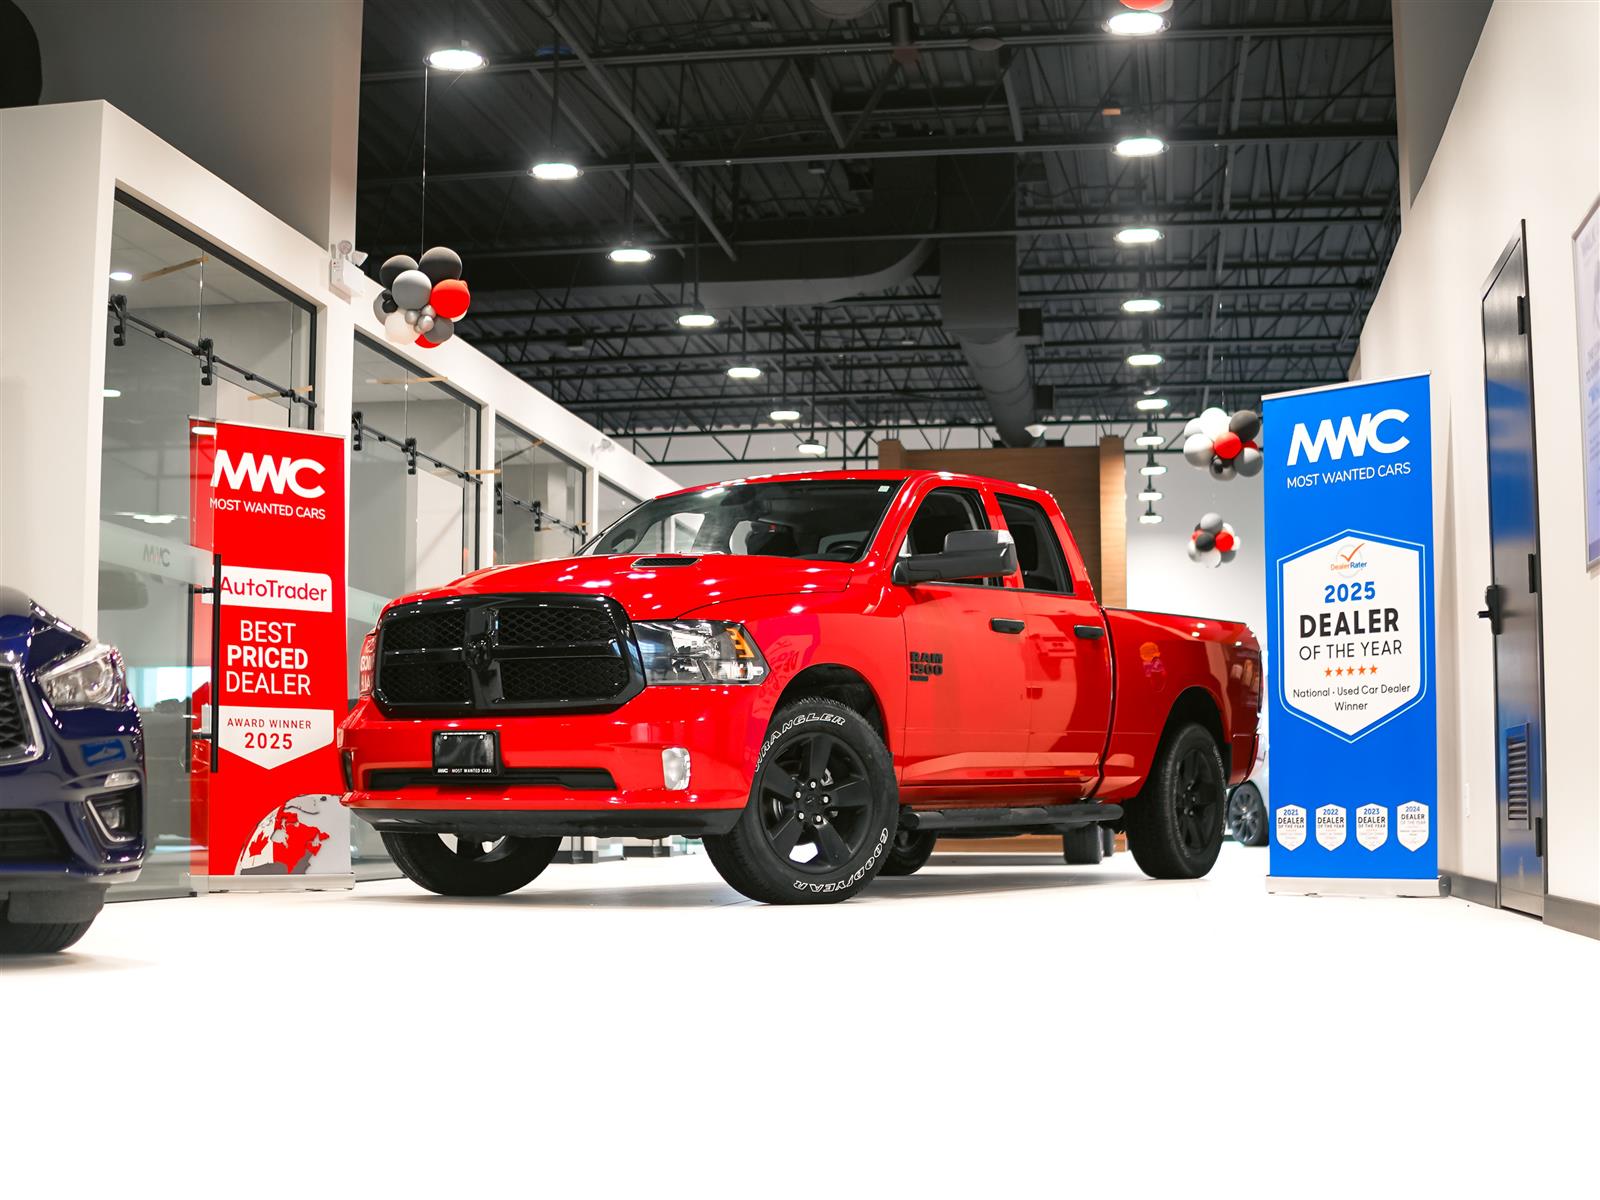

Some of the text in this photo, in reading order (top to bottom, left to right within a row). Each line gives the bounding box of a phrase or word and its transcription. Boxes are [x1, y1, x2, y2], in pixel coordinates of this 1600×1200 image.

[1287, 408, 1410, 466] MWC
[210, 449, 326, 498] MWC
[1287, 462, 1411, 489] MOST WANTED CARS
[210, 497, 326, 520] MOST WANTED CARS
[1330, 561, 1367, 571] DealerRater
[221, 576, 327, 601] AutoTrader
[1324, 581, 1376, 603] 2025
[240, 619, 296, 644] BEST
[1300, 607, 1399, 638] DEALER
[227, 644, 309, 670] PRICED
[910, 651, 943, 664] RAM
[1299, 640, 1402, 661] OF THE YEAR
[910, 663, 943, 675] 1500
[226, 670, 311, 696] DEALER
[1293, 688, 1330, 698] National
[1337, 686, 1359, 696] Used
[1361, 685, 1378, 694] Car
[1381, 683, 1410, 694] Dealer
[1335, 701, 1368, 711] Winner
[227, 718, 312, 730] AWARD WINNER
[244, 732, 293, 750] 2025
[793, 828, 889, 893] GOODYEAR
